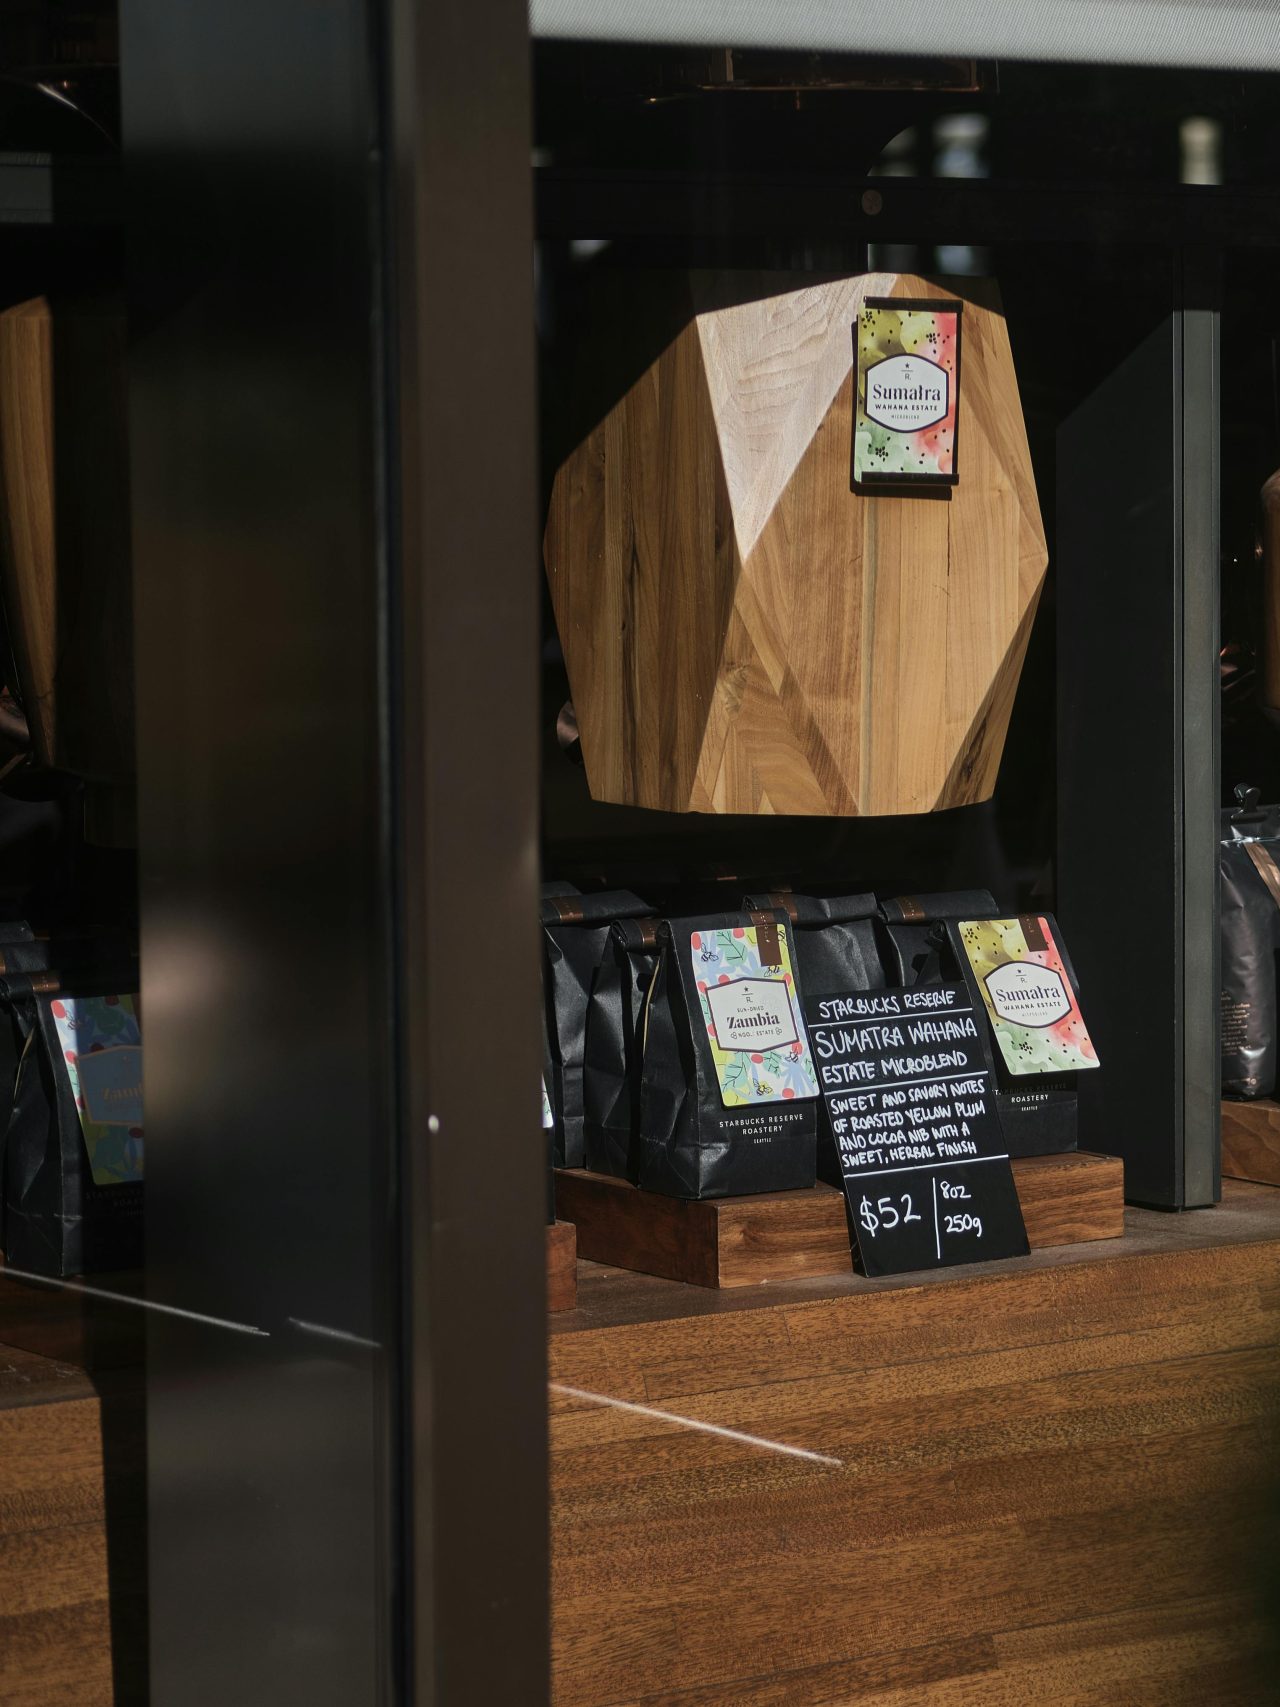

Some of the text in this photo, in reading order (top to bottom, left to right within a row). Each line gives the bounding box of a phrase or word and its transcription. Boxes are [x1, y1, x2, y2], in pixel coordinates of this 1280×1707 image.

[873, 384, 941, 401] Sumatra
[819, 990, 956, 1021] STARBUCKS RESERVE
[995, 985, 1061, 1003] Sumatra
[1003, 1001, 1062, 1011] WAHANA ESTATE
[726, 1012, 780, 1029] Zambia
[815, 1017, 978, 1058] SUMATRA WAHANA
[822, 1051, 967, 1084] ESTATE MICROBLEND
[831, 1093, 876, 1115] SWEET
[881, 1090, 906, 1107] AND
[908, 1083, 948, 1103] SAVORY
[950, 1078, 985, 1100] NOTES
[1011, 1094, 1049, 1103] ROASTERY
[719, 1113, 804, 1128] STARBUCKS RESERVE
[742, 1125, 783, 1135] ROASTERY
[833, 1100, 986, 1134] OF ROASTED YELLOW PLUM
[839, 1121, 970, 1151] AND COCOA NIB WITH A
[841, 1140, 977, 1168] SWEET, HERBAL FINISH
[859, 1193, 921, 1238] $52
[944, 1214, 982, 1239] 250g
